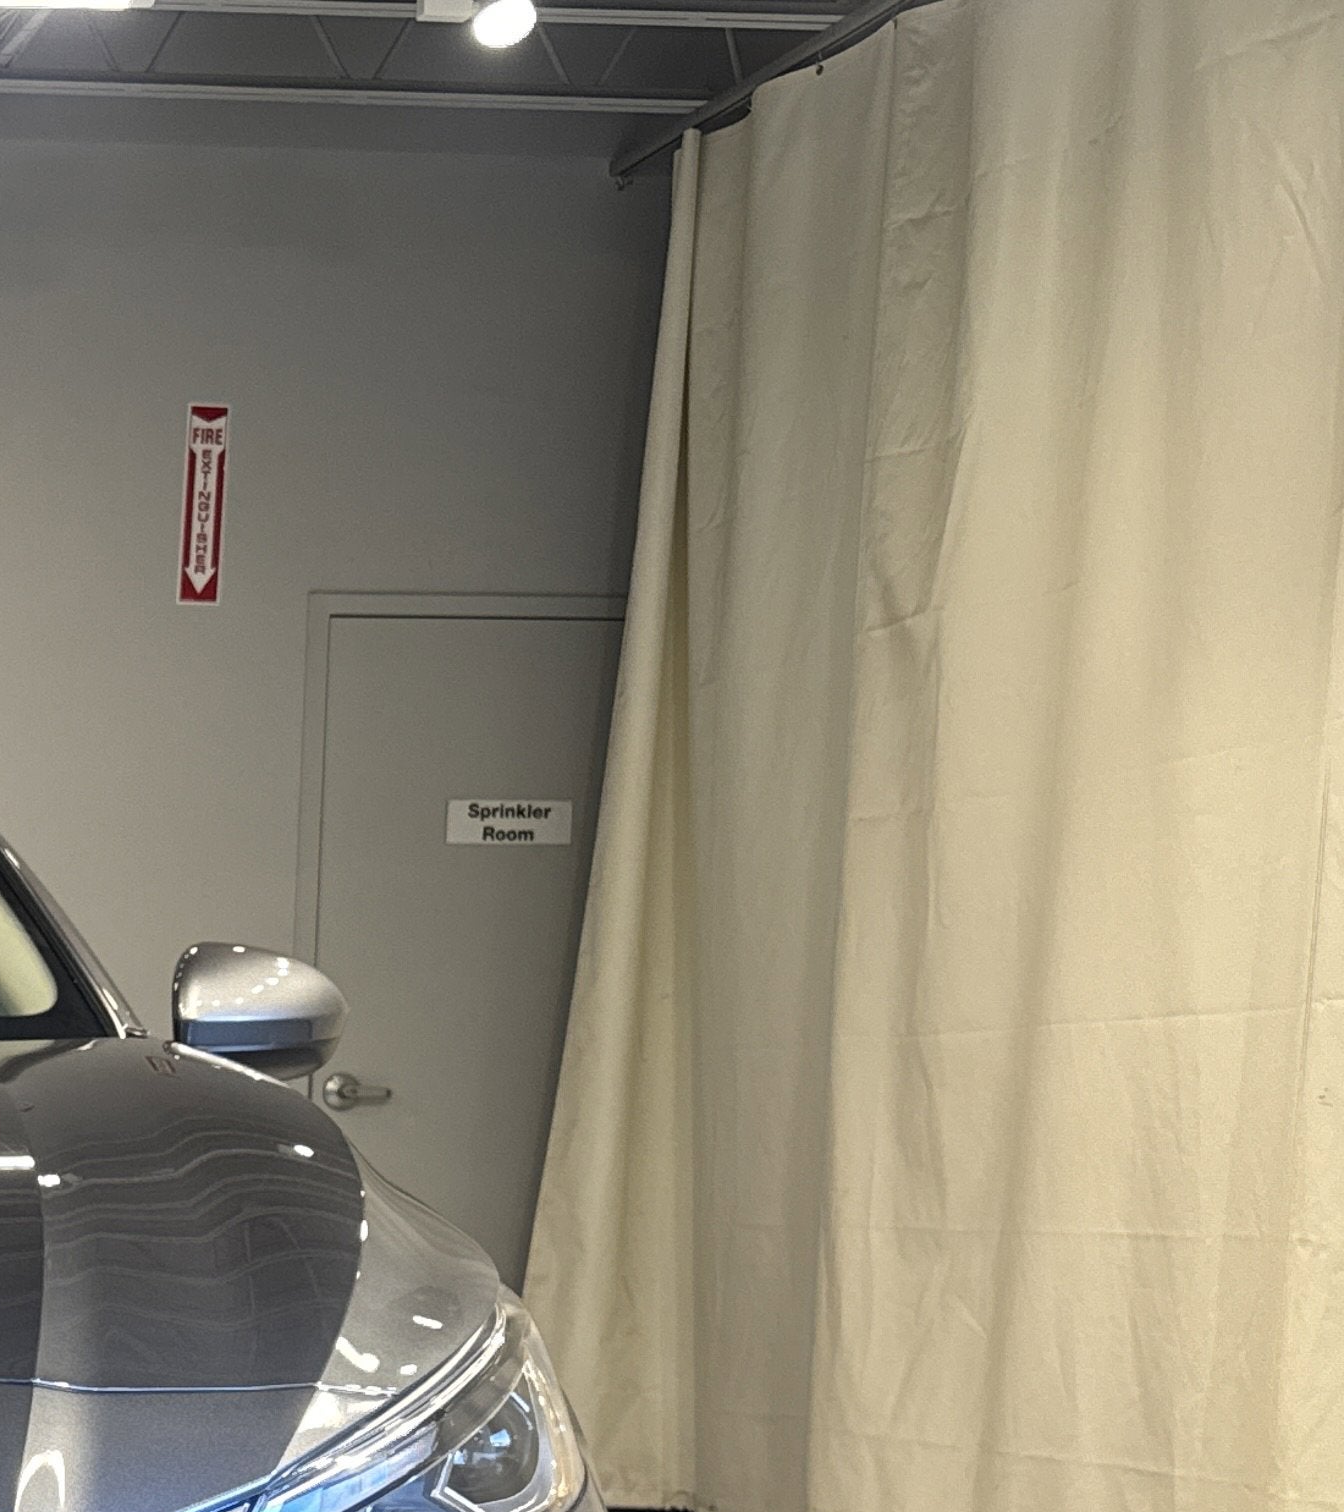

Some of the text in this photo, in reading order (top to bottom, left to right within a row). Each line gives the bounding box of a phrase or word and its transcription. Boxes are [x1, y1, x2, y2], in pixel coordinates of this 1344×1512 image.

[192, 427, 223, 445] FIRE
[194, 449, 212, 575] EXTINGUISHER
[467, 803, 552, 821] Sprinkler
[482, 826, 535, 842] Room
